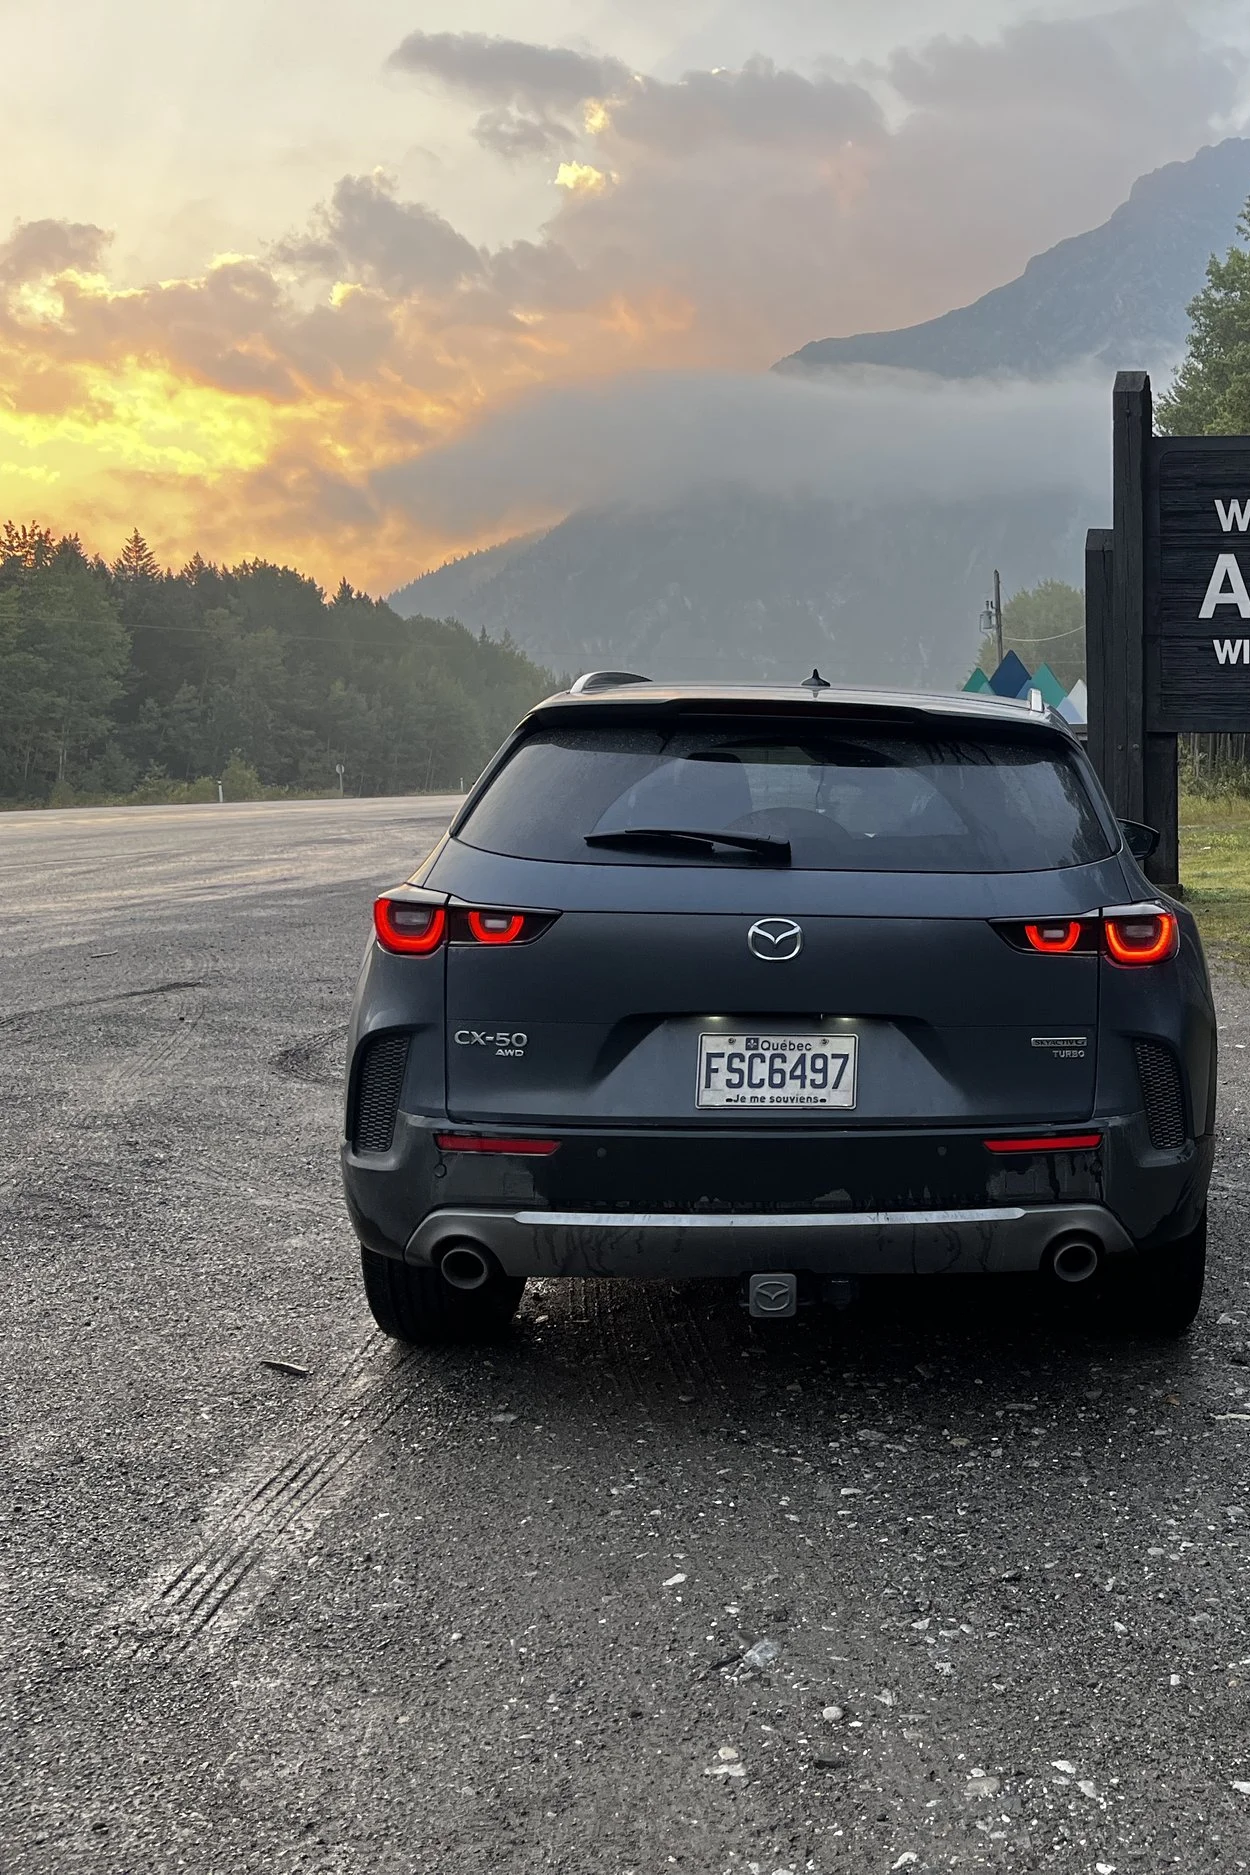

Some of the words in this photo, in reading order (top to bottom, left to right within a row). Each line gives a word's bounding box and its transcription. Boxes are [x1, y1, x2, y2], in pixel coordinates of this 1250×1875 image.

[454, 1030, 528, 1047] CX-50
[760, 1039, 812, 1051] Québec
[495, 1049, 524, 1057] AWD
[1052, 1050, 1085, 1058] TURBO
[704, 1052, 849, 1090] FSC6497
[733, 1094, 747, 1104] Je
[750, 1096, 766, 1104] me
[769, 1094, 819, 1104] souviens
